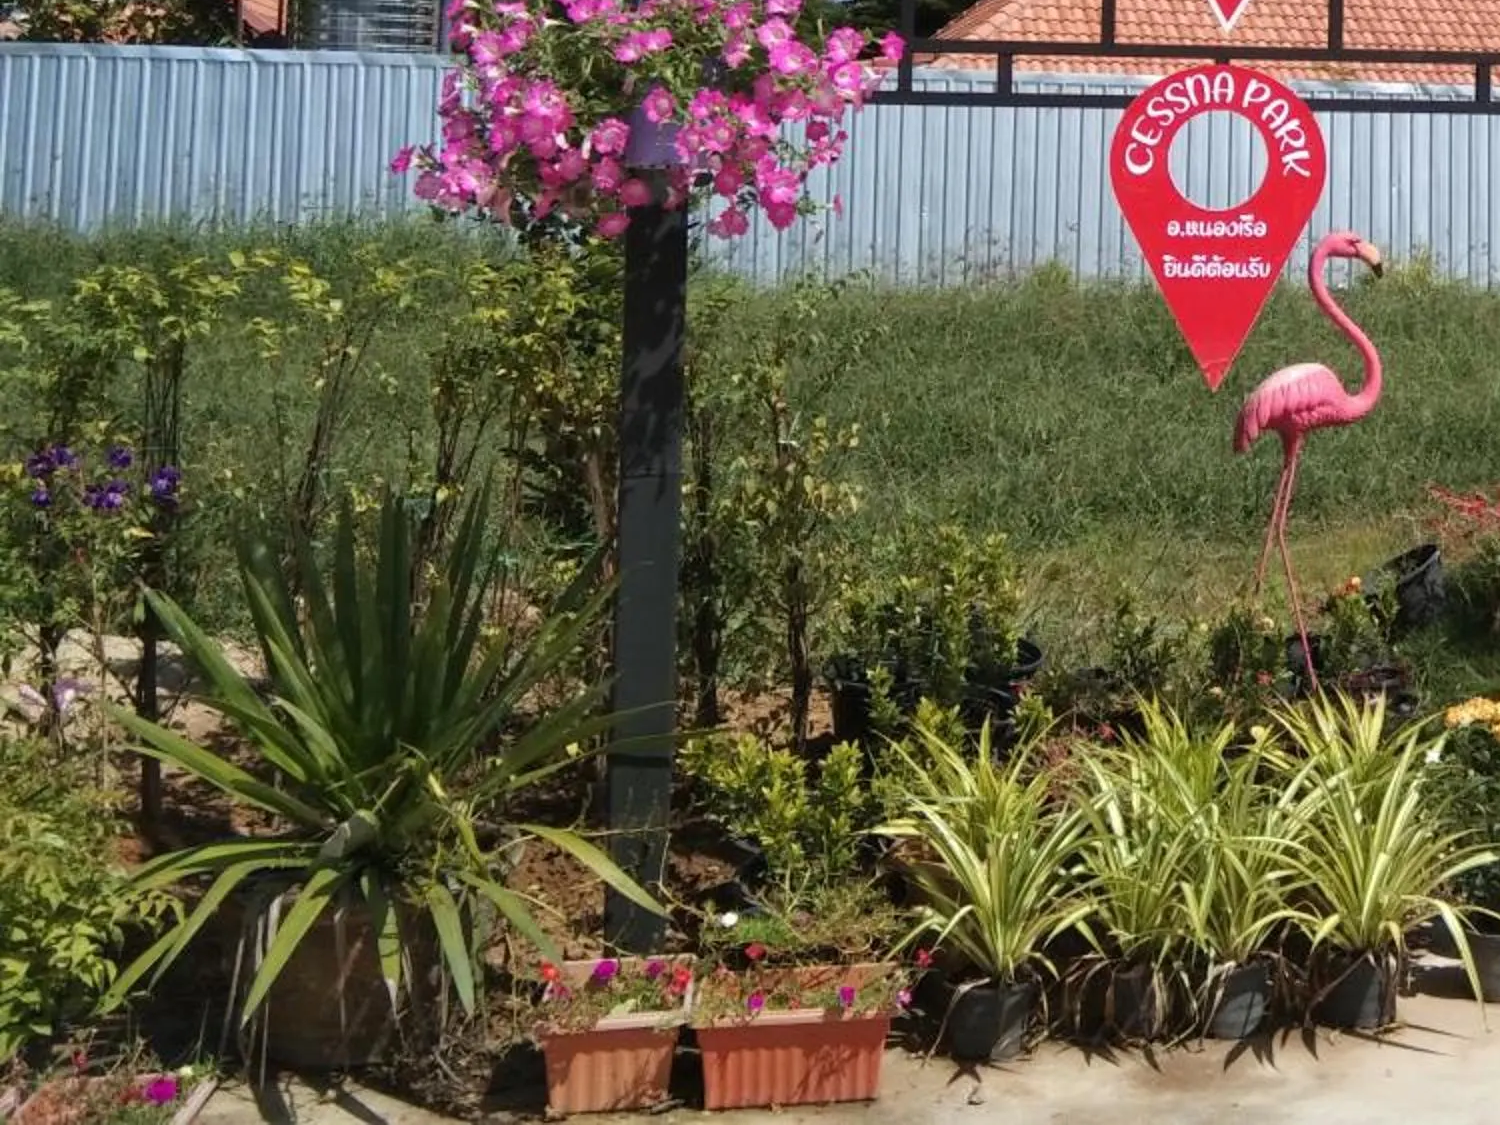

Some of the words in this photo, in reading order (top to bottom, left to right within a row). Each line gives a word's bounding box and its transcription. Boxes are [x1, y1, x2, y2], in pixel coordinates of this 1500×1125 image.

[1125, 71, 1235, 175] CESSNA
[1242, 79, 1311, 177] PARK
[1167, 214, 1267, 237] อ.หนองเรือ
[1162, 254, 1271, 279] ยินดีต้อนรับ
